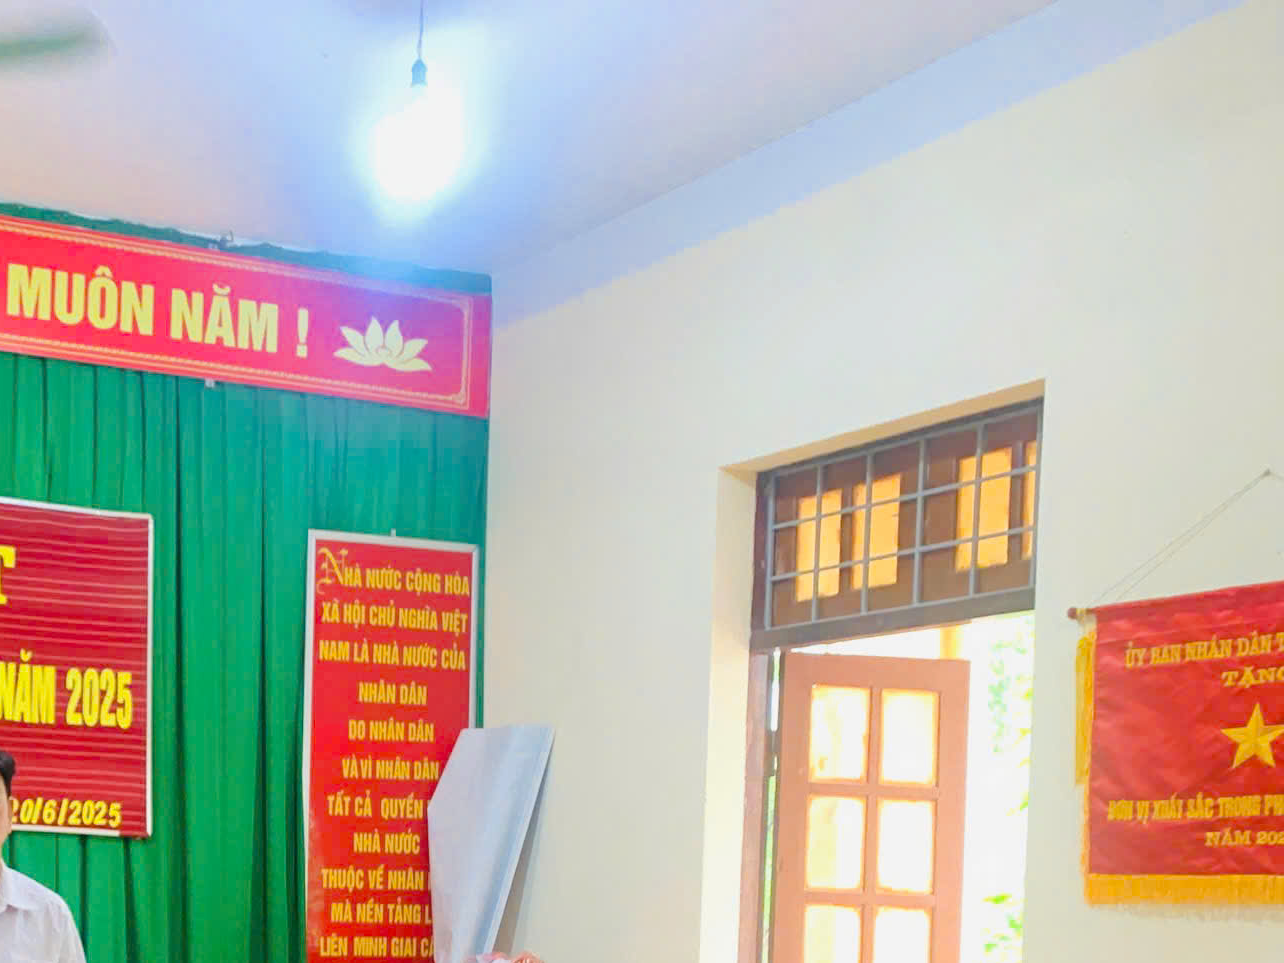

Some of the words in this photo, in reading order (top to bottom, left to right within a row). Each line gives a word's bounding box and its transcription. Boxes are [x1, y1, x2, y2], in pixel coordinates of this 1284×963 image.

[7, 264, 155, 336] MUÔN
[171, 284, 279, 353] NĂM
[317, 547, 362, 594] NHÀ
[366, 565, 402, 591] NƯỚC
[406, 568, 441, 596] CỘNG
[445, 571, 470, 597] HÒA
[322, 598, 340, 623] XÃ
[343, 600, 366, 629] HỘI
[369, 600, 396, 627] CHỦ
[399, 605, 438, 631] NGHĨA
[442, 609, 468, 637] VIỆT
[319, 639, 350, 662] NAM
[354, 638, 369, 663] LÀ
[373, 641, 399, 665] NHÀ
[403, 643, 437, 668] NƯỚC
[441, 643, 466, 670] CỦA
[1185, 634, 1232, 662] NHÂN
[1236, 630, 1272, 657] DÂN
[65, 667, 133, 730] 2025
[359, 679, 396, 704] NHÂN
[400, 681, 428, 706] DÂN
[348, 719, 366, 741] DO
[369, 716, 405, 742] NHÂN
[408, 719, 435, 743] DÂN
[342, 756, 358, 780] VÀ
[360, 757, 373, 780] VÌ
[376, 756, 411, 780] NHÂN
[414, 757, 439, 781] DÂN
[327, 790, 351, 817] TẤT
[355, 790, 373, 817] CẢ
[353, 828, 381, 854] NHÀ
[385, 828, 421, 855] NƯỚC
[1204, 826, 1251, 847] NĂM
[1255, 830, 1284, 846] 202
[321, 866, 364, 892] THUỘC
[388, 867, 424, 890] NHÂN
[331, 898, 352, 923] MÀ
[388, 896, 421, 924] TẢNG
[320, 932, 348, 957] LIÊN
[353, 936, 387, 957] MINH
[391, 936, 417, 957] GIAI
